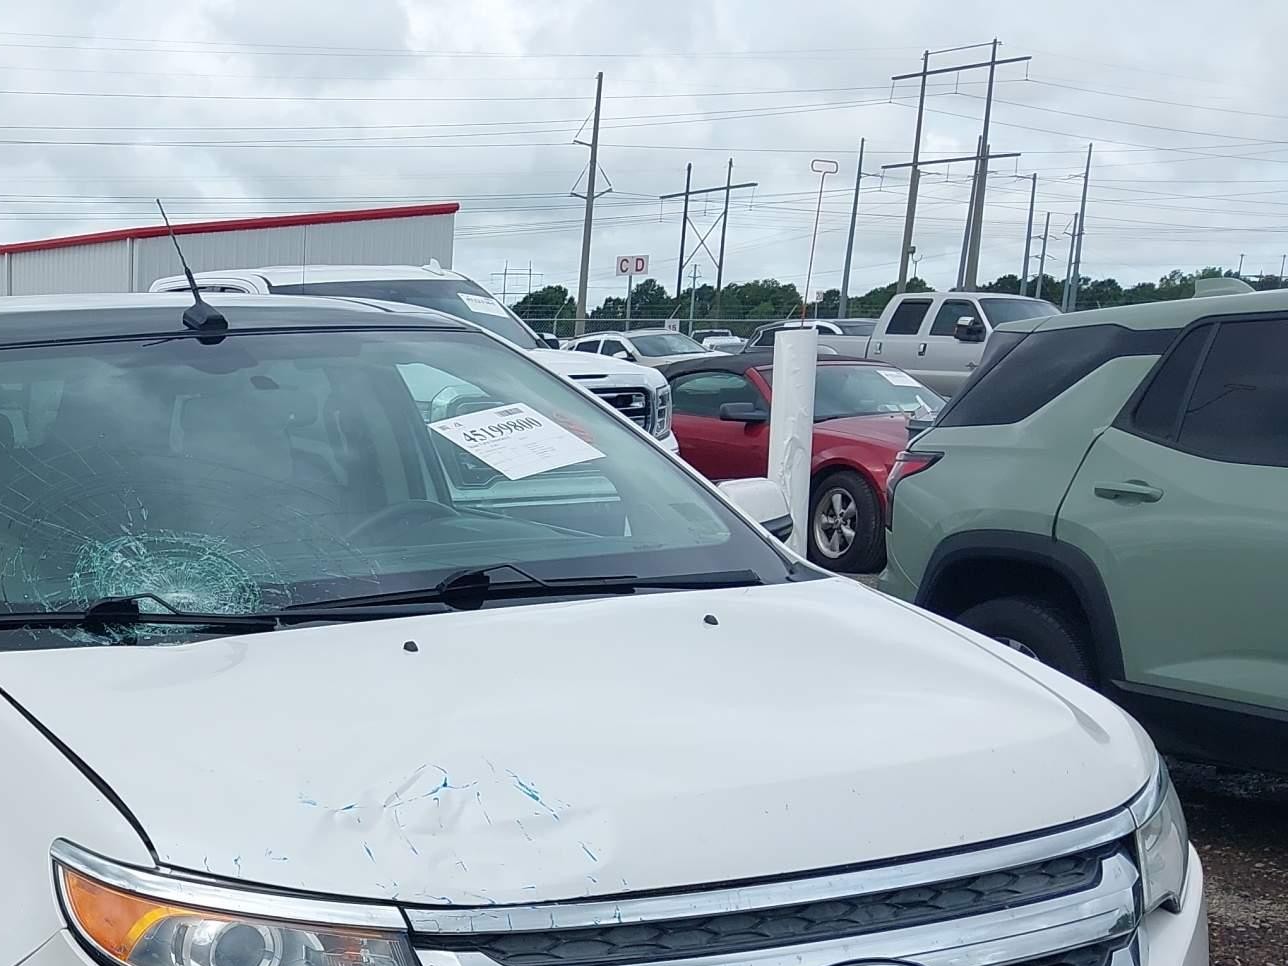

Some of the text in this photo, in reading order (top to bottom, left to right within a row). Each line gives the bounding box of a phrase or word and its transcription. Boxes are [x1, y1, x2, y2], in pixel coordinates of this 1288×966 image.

[619, 257, 645, 273] C D
[463, 416, 543, 444] 45199800
